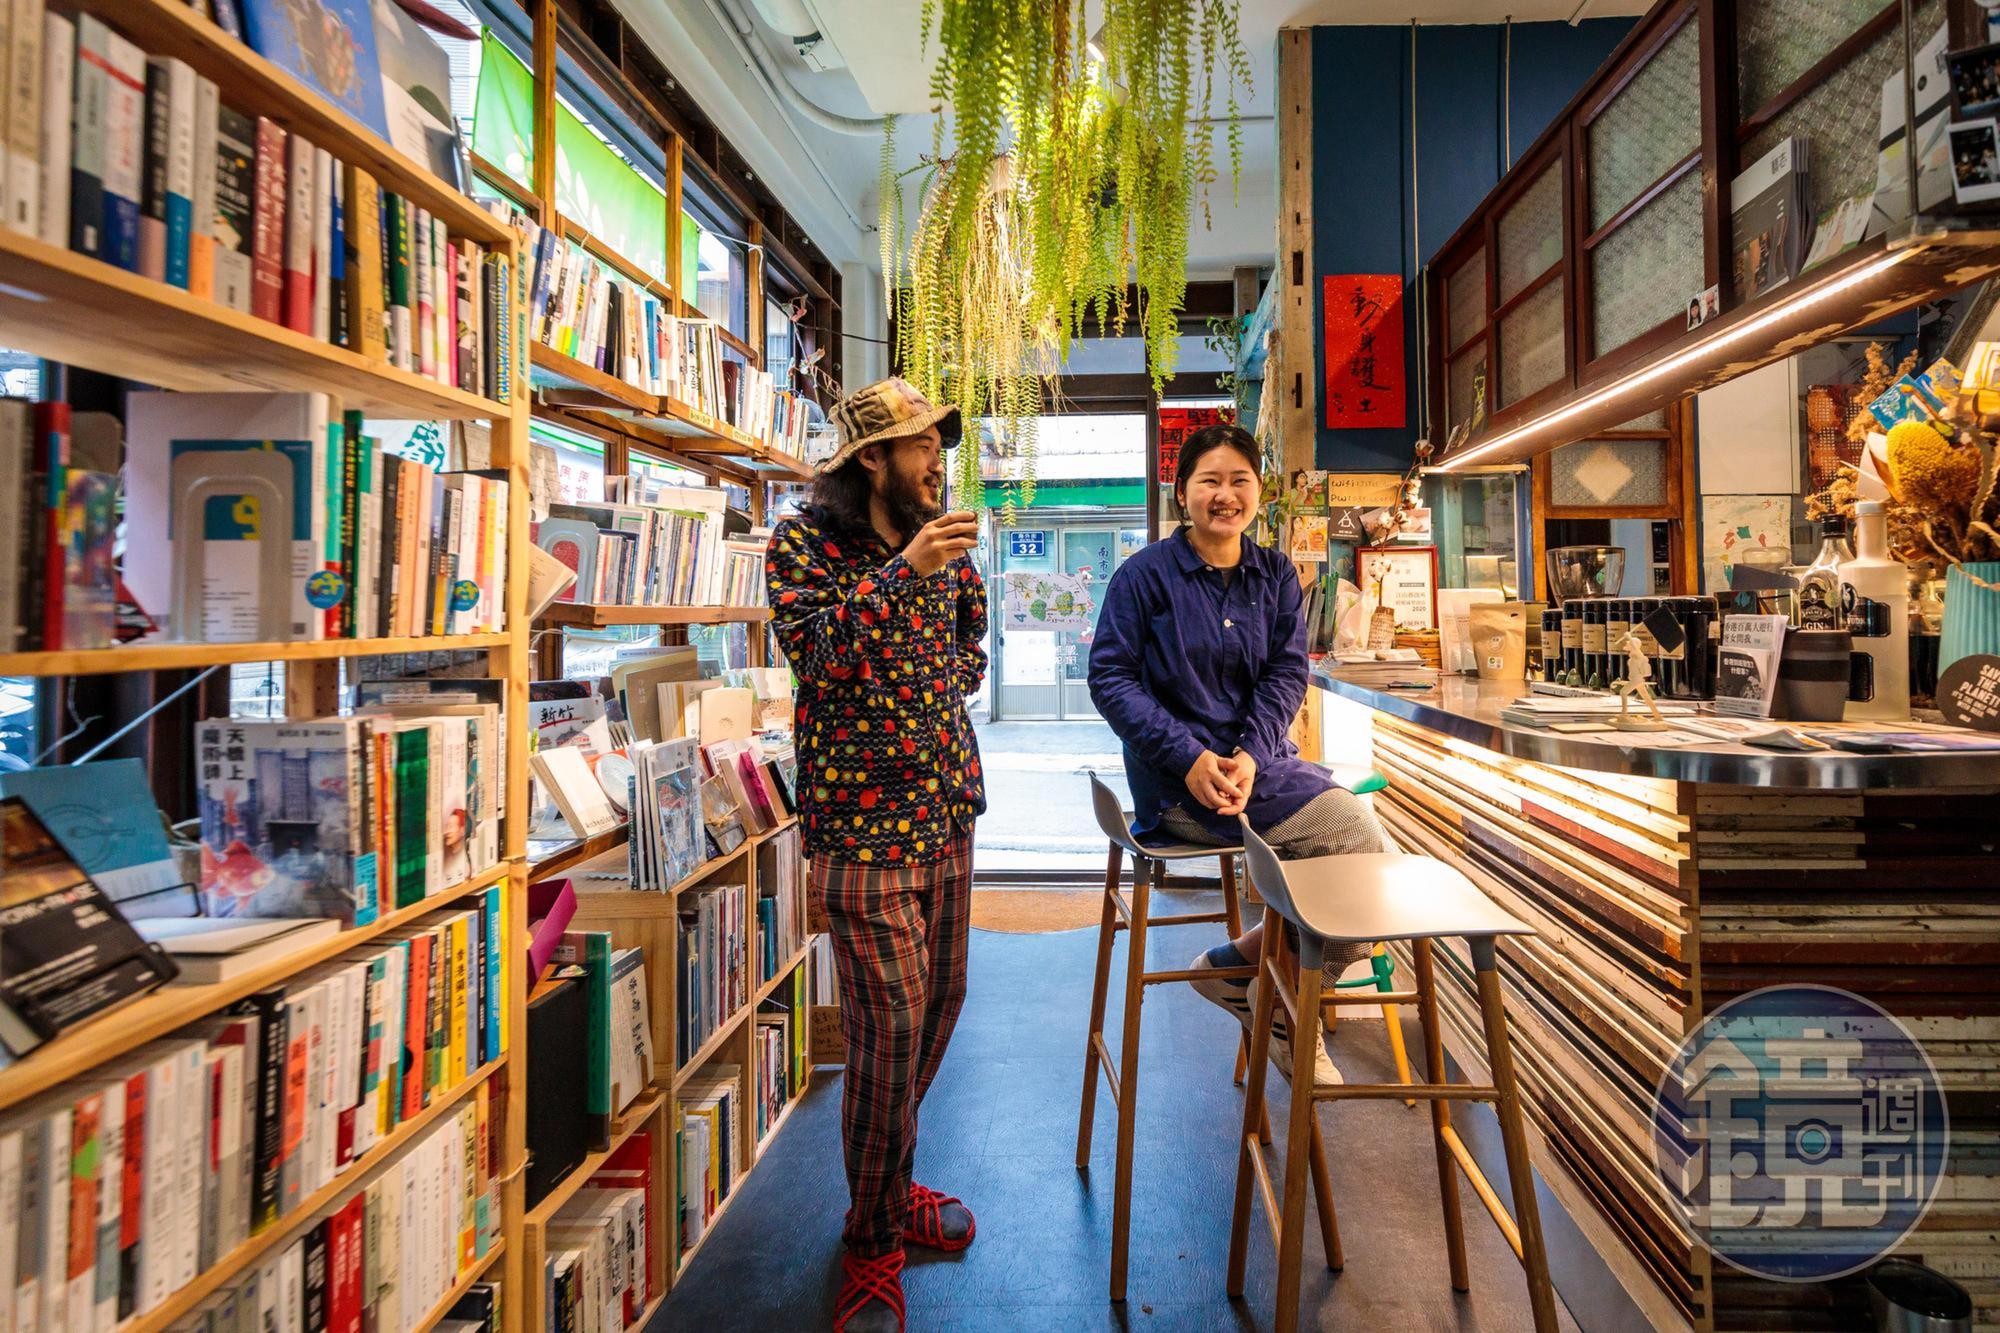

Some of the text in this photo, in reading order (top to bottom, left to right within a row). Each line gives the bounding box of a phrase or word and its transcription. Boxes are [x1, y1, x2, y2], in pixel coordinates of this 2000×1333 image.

[1019, 543, 1037, 554] 32
[1805, 622, 1824, 631] GIN
[1977, 676, 1997, 693] THE
[540, 704, 575, 727] 新竹
